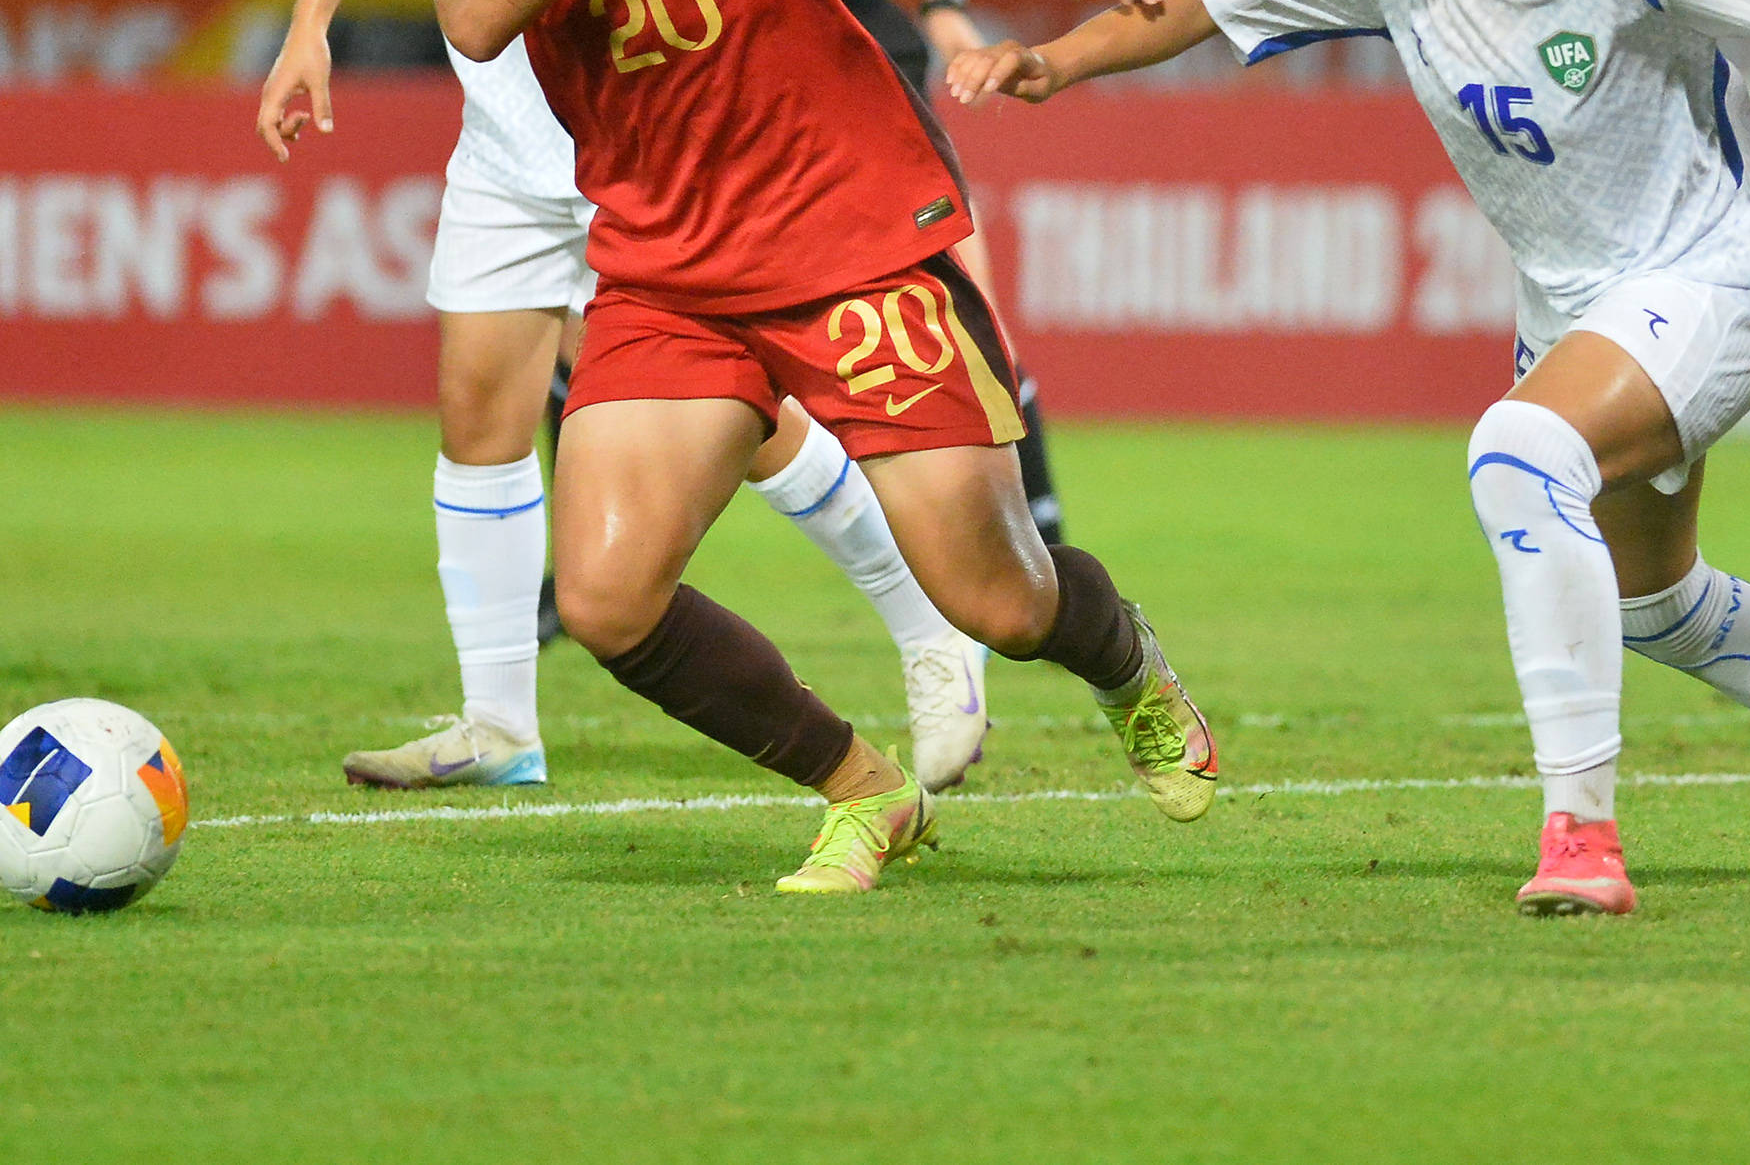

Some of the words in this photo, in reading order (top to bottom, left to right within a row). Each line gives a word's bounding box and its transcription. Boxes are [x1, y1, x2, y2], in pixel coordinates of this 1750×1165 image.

[1546, 41, 1591, 67] UFA
[1458, 83, 1556, 166] 15
[0, 175, 285, 323] EN'S
[293, 175, 445, 323] AS
[827, 283, 955, 396] 20
